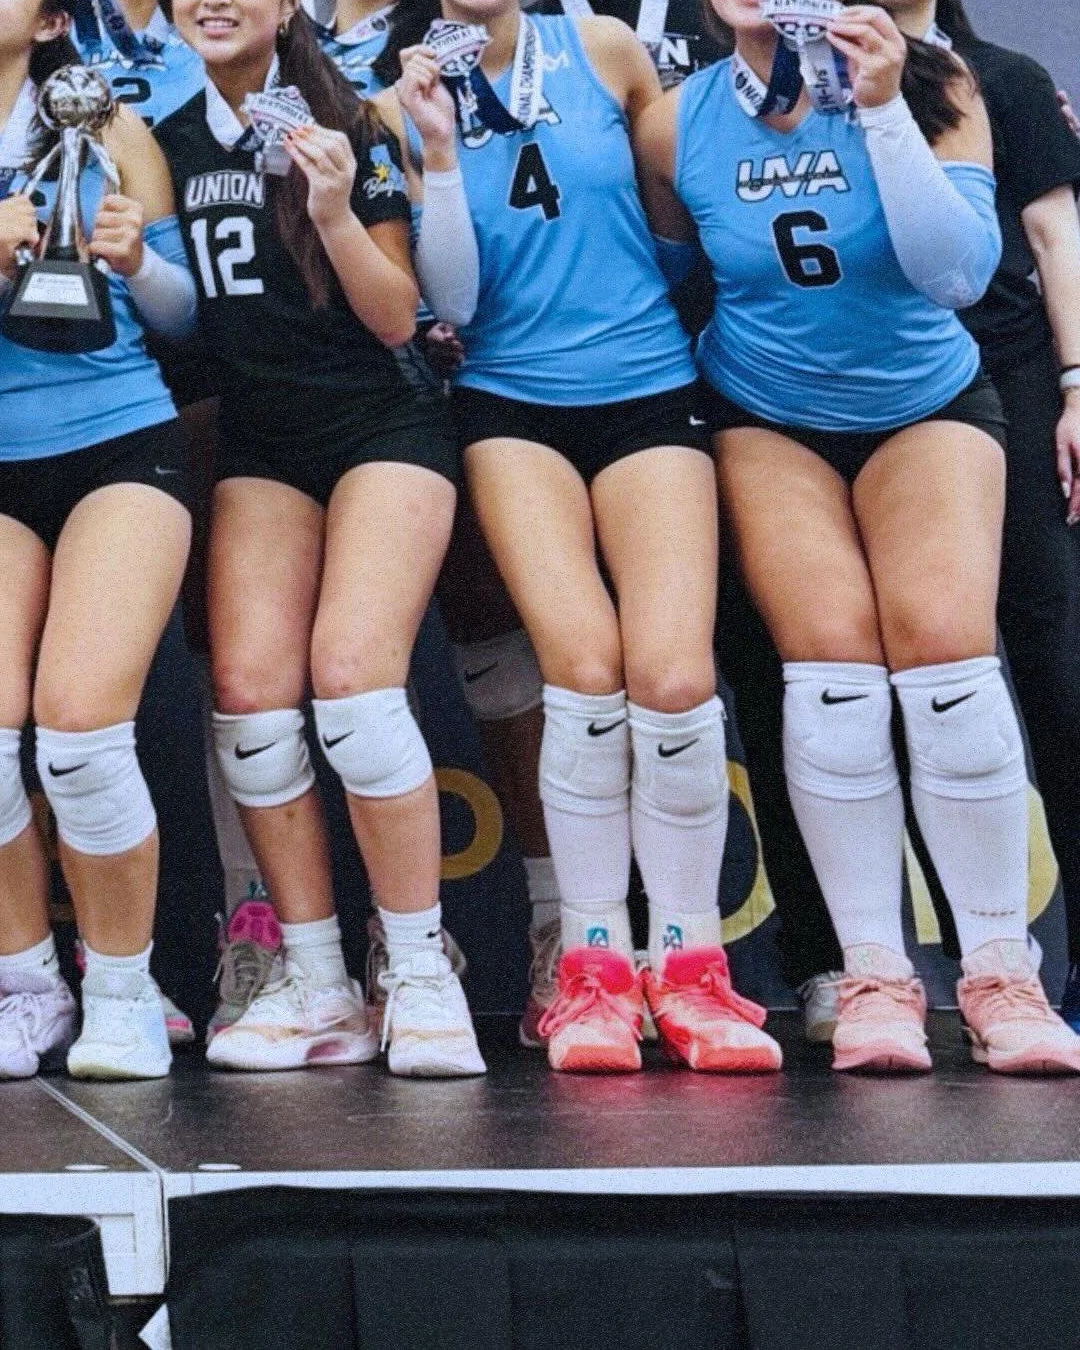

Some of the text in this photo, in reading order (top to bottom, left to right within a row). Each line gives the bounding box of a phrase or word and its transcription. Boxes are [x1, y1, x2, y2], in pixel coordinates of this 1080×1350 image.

[185, 170, 265, 212] UNION
[508, 141, 562, 221] 4
[735, 150, 852, 203] UVA
[190, 216, 265, 298] 12
[772, 210, 843, 289] 6
